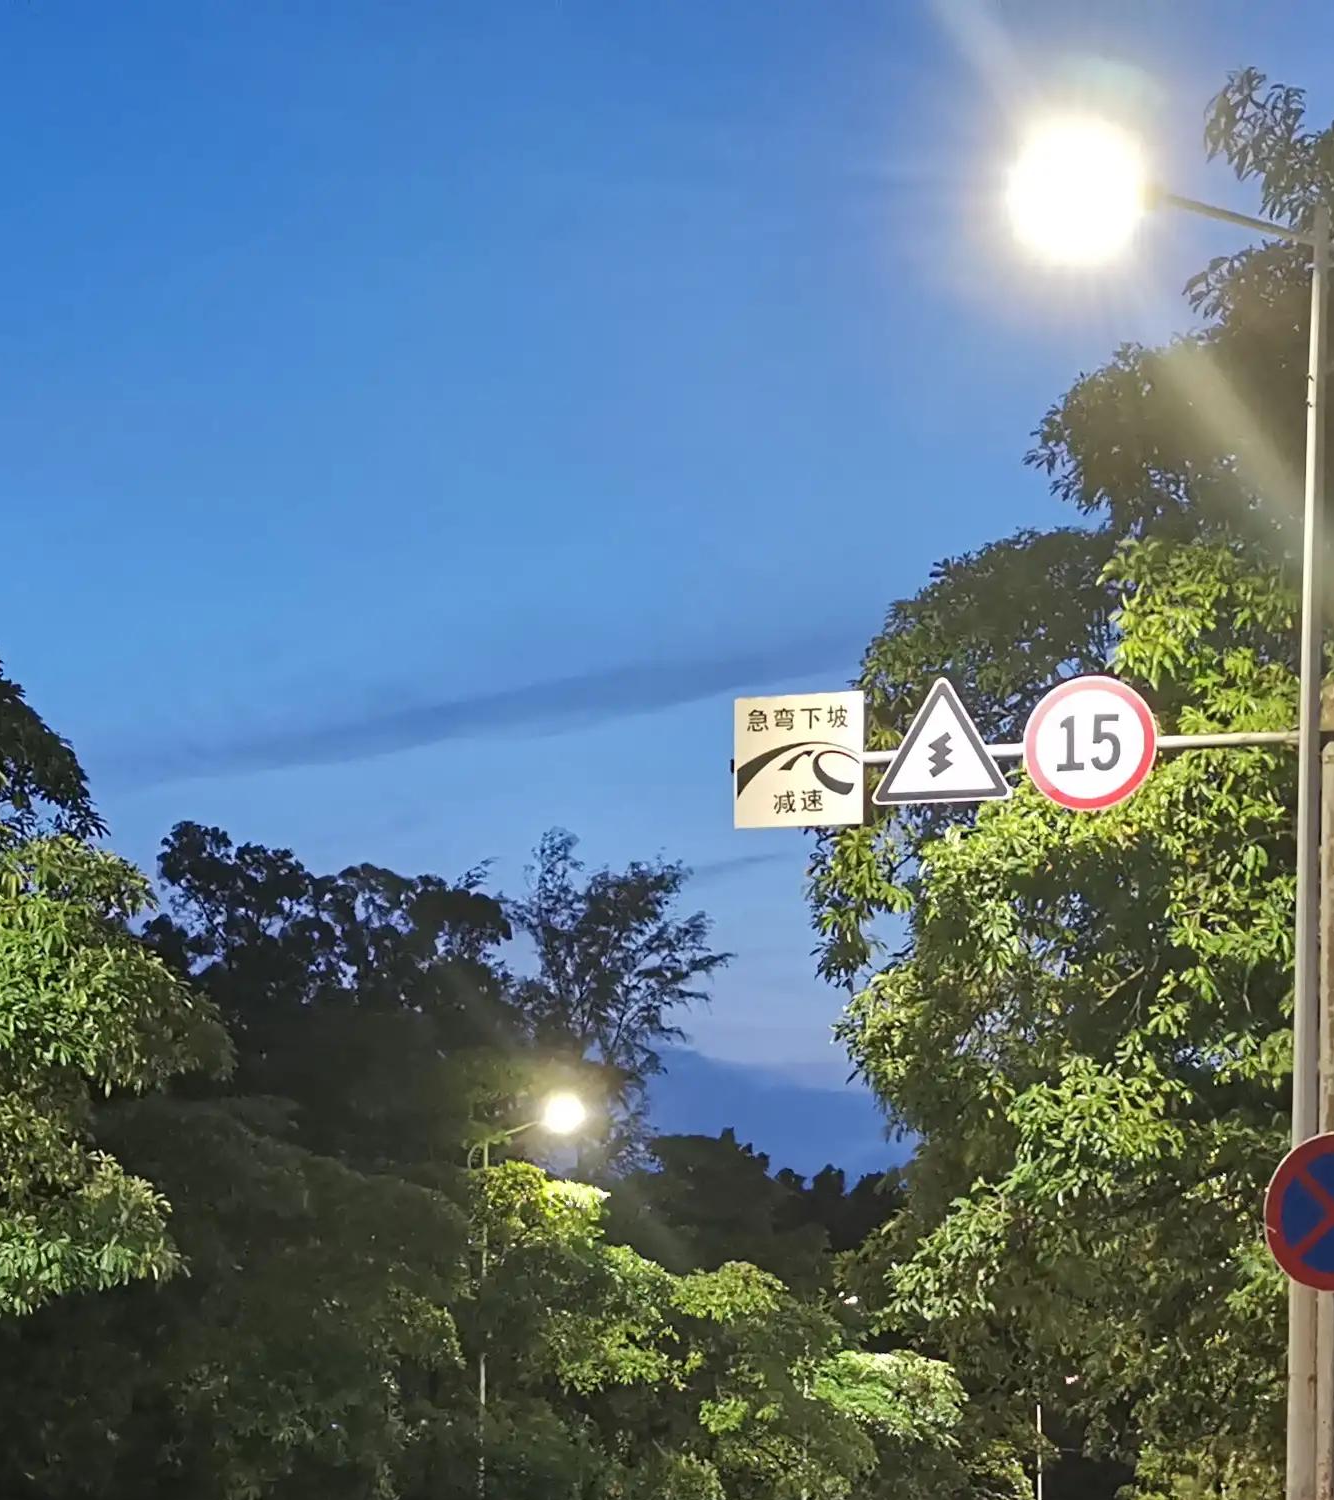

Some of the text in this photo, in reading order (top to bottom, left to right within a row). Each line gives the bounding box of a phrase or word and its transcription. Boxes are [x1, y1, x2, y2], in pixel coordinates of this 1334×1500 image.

[747, 705, 848, 732] 急弯下坡
[1056, 713, 1121, 772] 15
[773, 789, 823, 814] 减速
